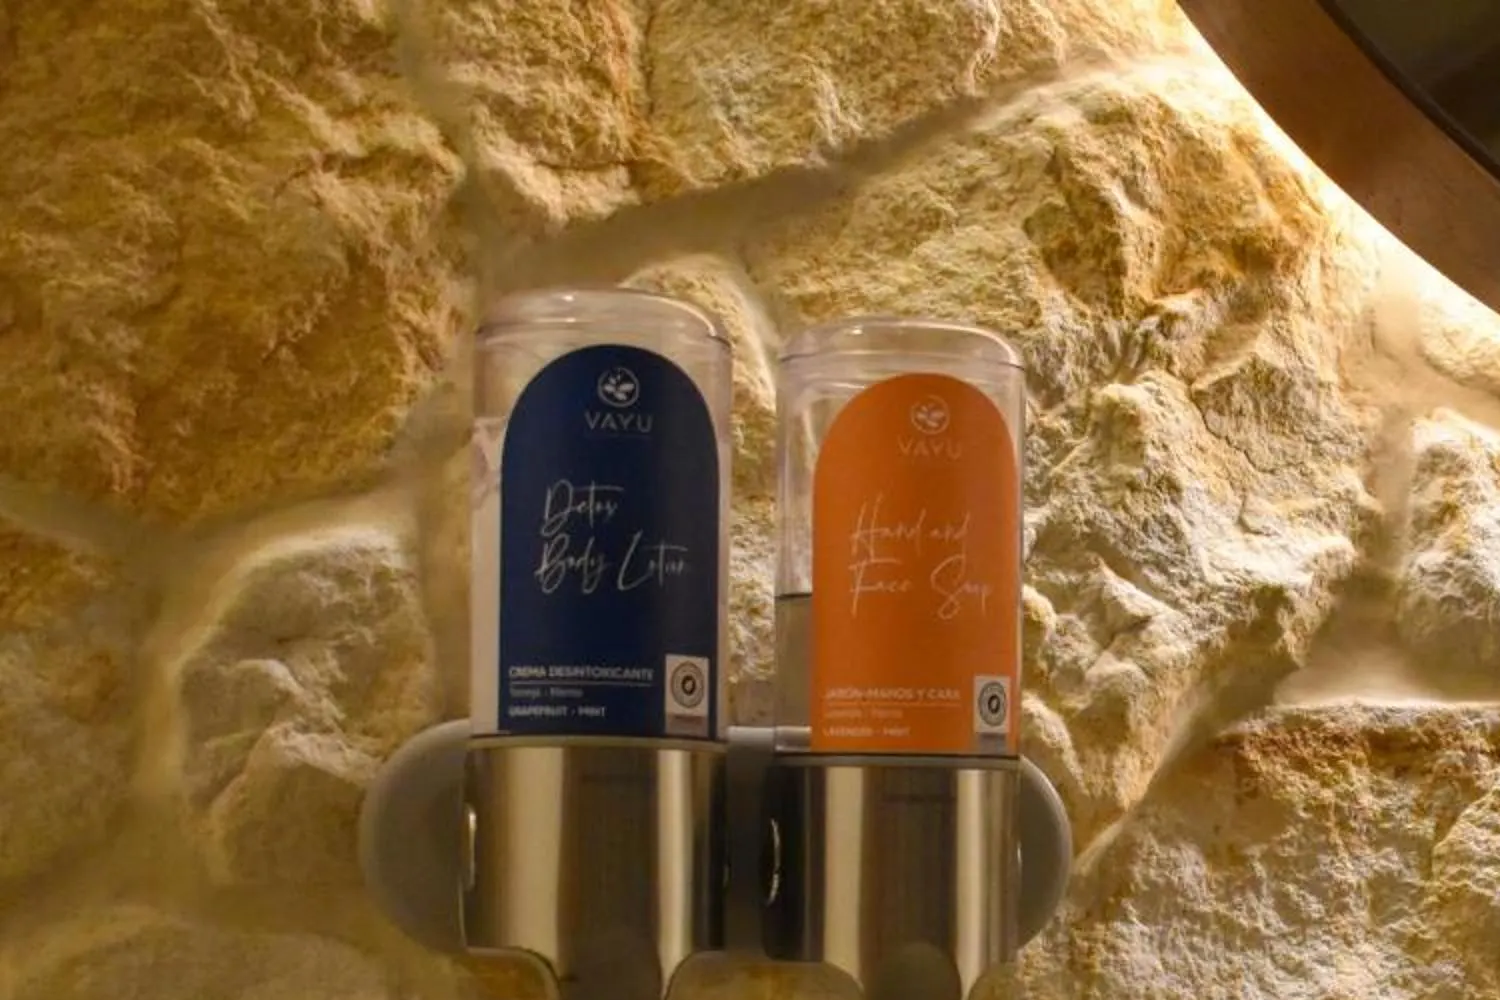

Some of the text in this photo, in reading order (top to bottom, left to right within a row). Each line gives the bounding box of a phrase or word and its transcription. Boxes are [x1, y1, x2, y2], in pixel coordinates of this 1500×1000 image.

[584, 411, 653, 433] VAYU
[897, 434, 962, 459] VAYU
[540, 479, 625, 537] Detox
[850, 492, 971, 563] Hand and
[534, 533, 607, 594] Body
[848, 551, 993, 621] Face Soap
[509, 665, 546, 678] CREMA
